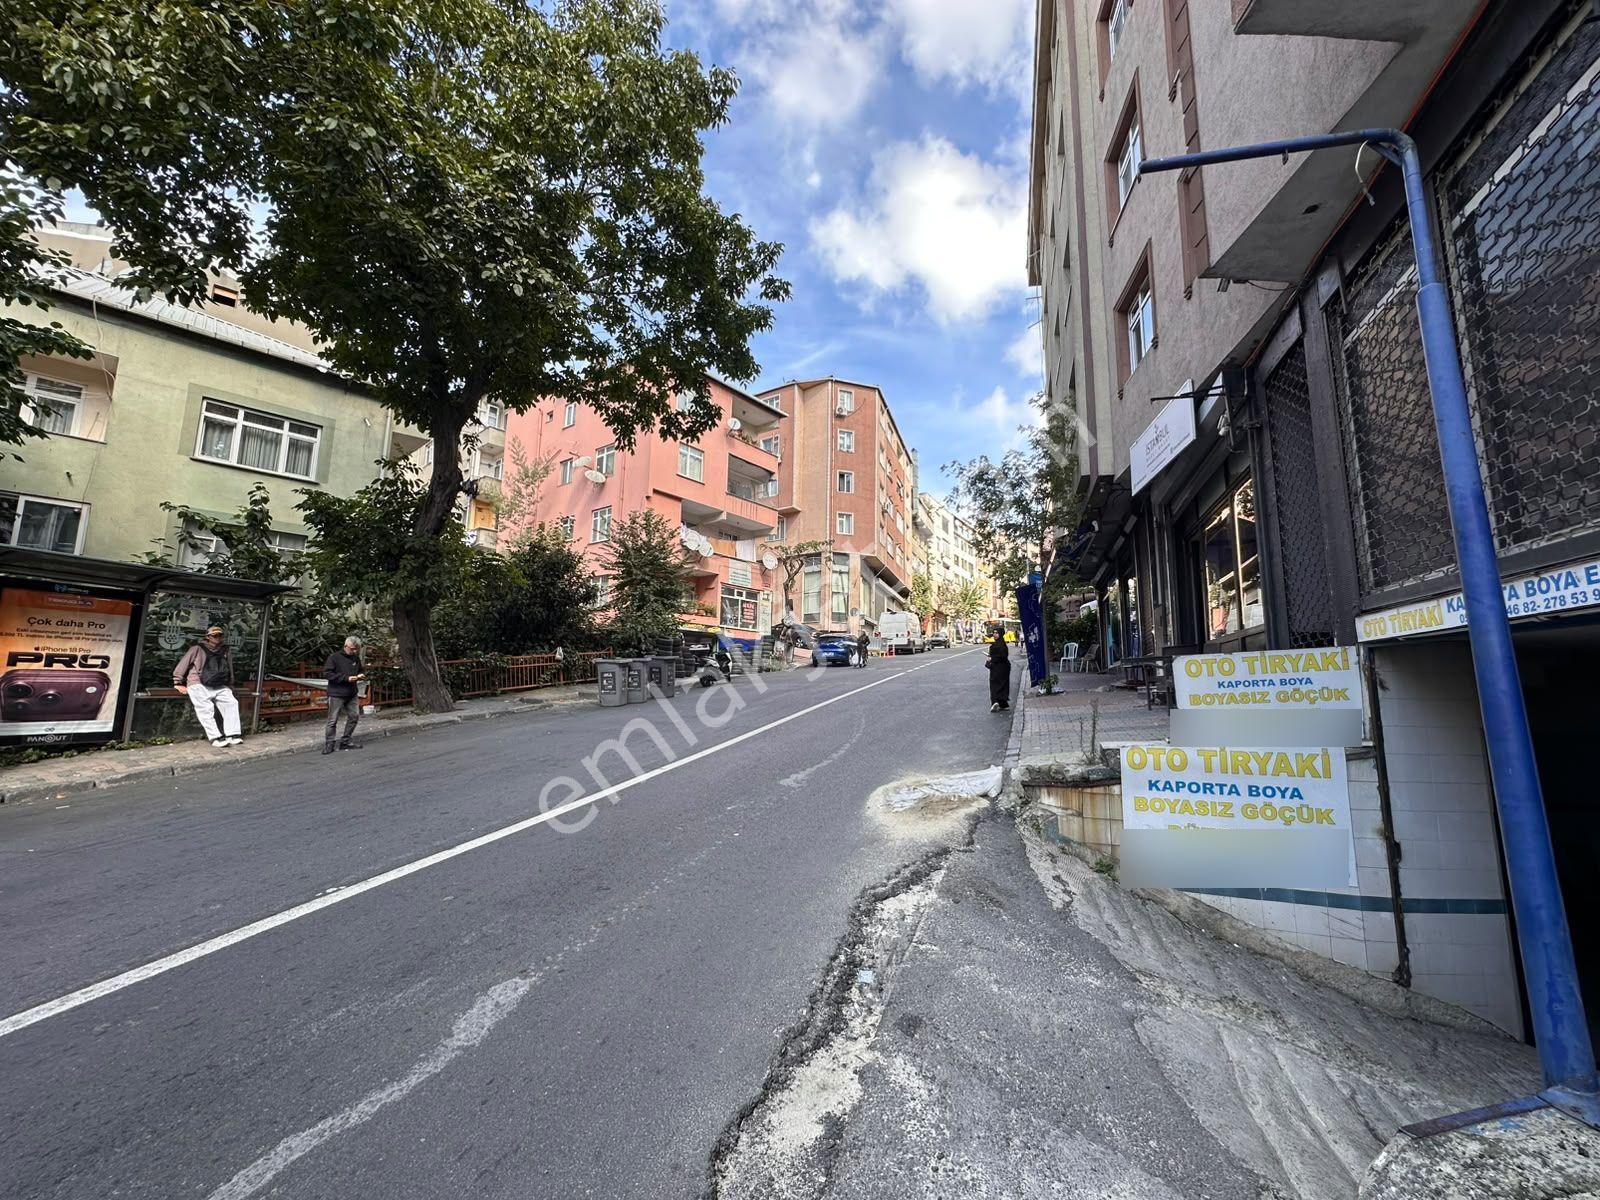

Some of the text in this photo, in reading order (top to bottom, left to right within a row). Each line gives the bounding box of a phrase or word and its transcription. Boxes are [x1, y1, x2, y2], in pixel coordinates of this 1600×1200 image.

[1363, 617, 1387, 638] OTO
[1388, 600, 1444, 634] TİRYAKİ
[1524, 570, 1580, 598] BOYA
[1543, 595, 1567, 610] 278
[1570, 590, 1589, 605] 53
[26, 616, 106, 629] Çok daha Pro
[6, 651, 111, 669] PRO
[1184, 647, 1350, 678] OTO TİRYAKİ
[1217, 677, 1314, 689] KAPORTA BOYA
[1188, 686, 1351, 706] BOYASIZ GÖÇÜK
[1125, 746, 1333, 779] OTO TİRYAKİ
[1147, 779, 1304, 800] KAPORTA BOYA
[1133, 796, 1336, 825] BOYASIZ GÖÇÜK
